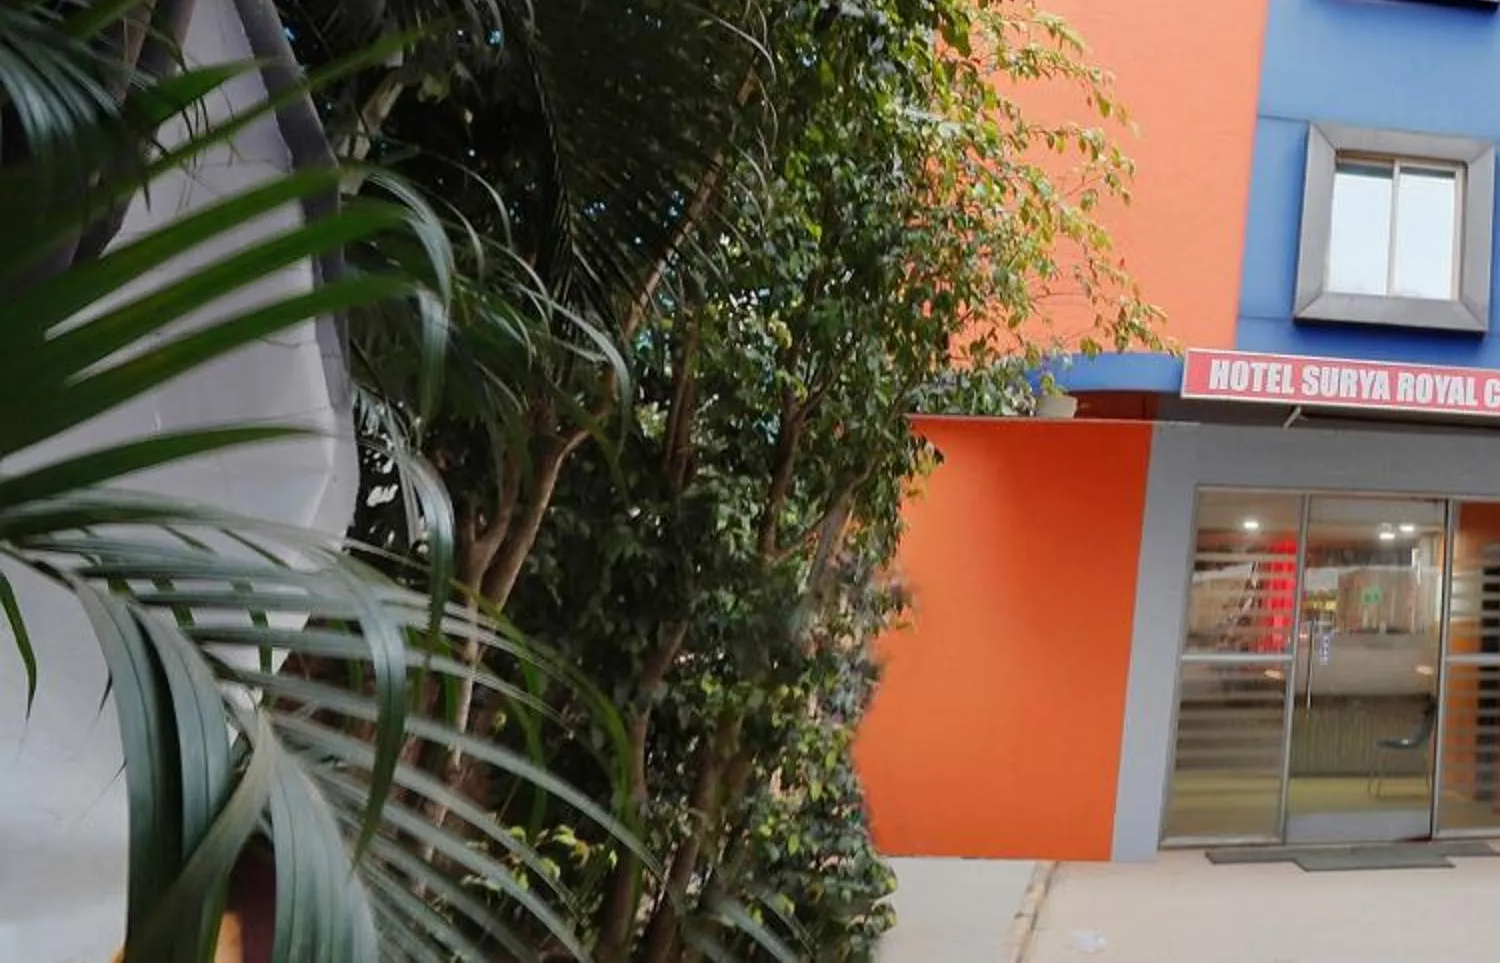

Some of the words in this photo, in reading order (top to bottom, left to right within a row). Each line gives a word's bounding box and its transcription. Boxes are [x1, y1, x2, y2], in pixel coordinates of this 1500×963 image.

[1209, 358, 1295, 395] HOTEL
[1301, 364, 1391, 401] SURYA
[1396, 371, 1479, 407] ROYAL
